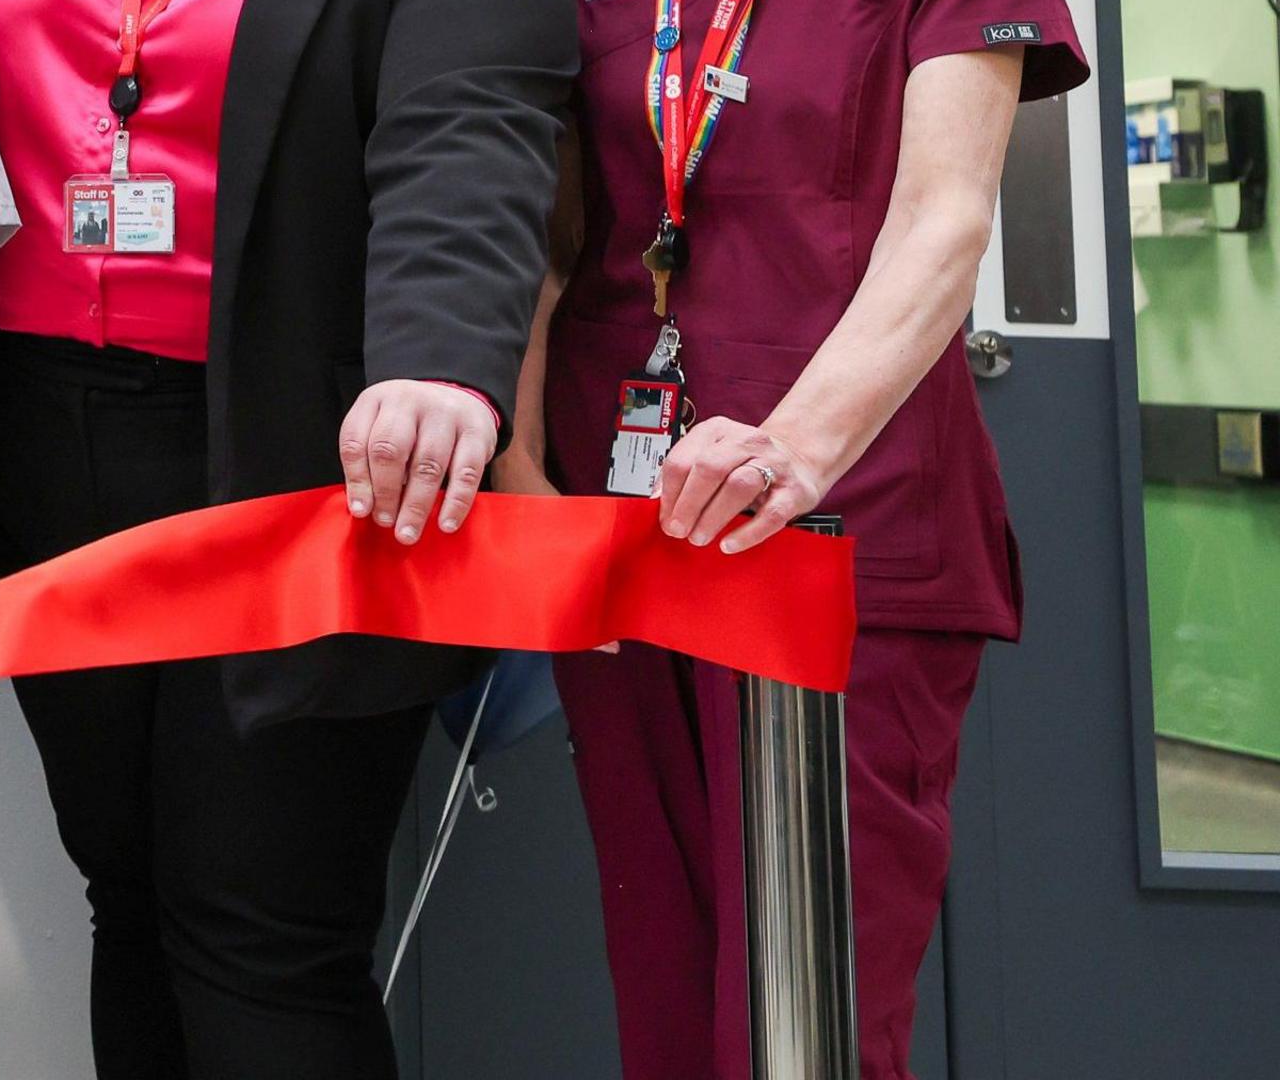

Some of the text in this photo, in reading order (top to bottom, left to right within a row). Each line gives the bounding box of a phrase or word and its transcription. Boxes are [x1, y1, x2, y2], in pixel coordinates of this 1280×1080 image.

[720, 0, 736, 30] SKILLS
[730, 24, 749, 56] NHS
[990, 25, 1015, 40] koi
[648, 73, 660, 107] NHS
[705, 93, 725, 121] NH
[685, 149, 702, 179] NHS
[74, 190, 108, 199] Staff ID
[661, 391, 673, 428] Staff ID
